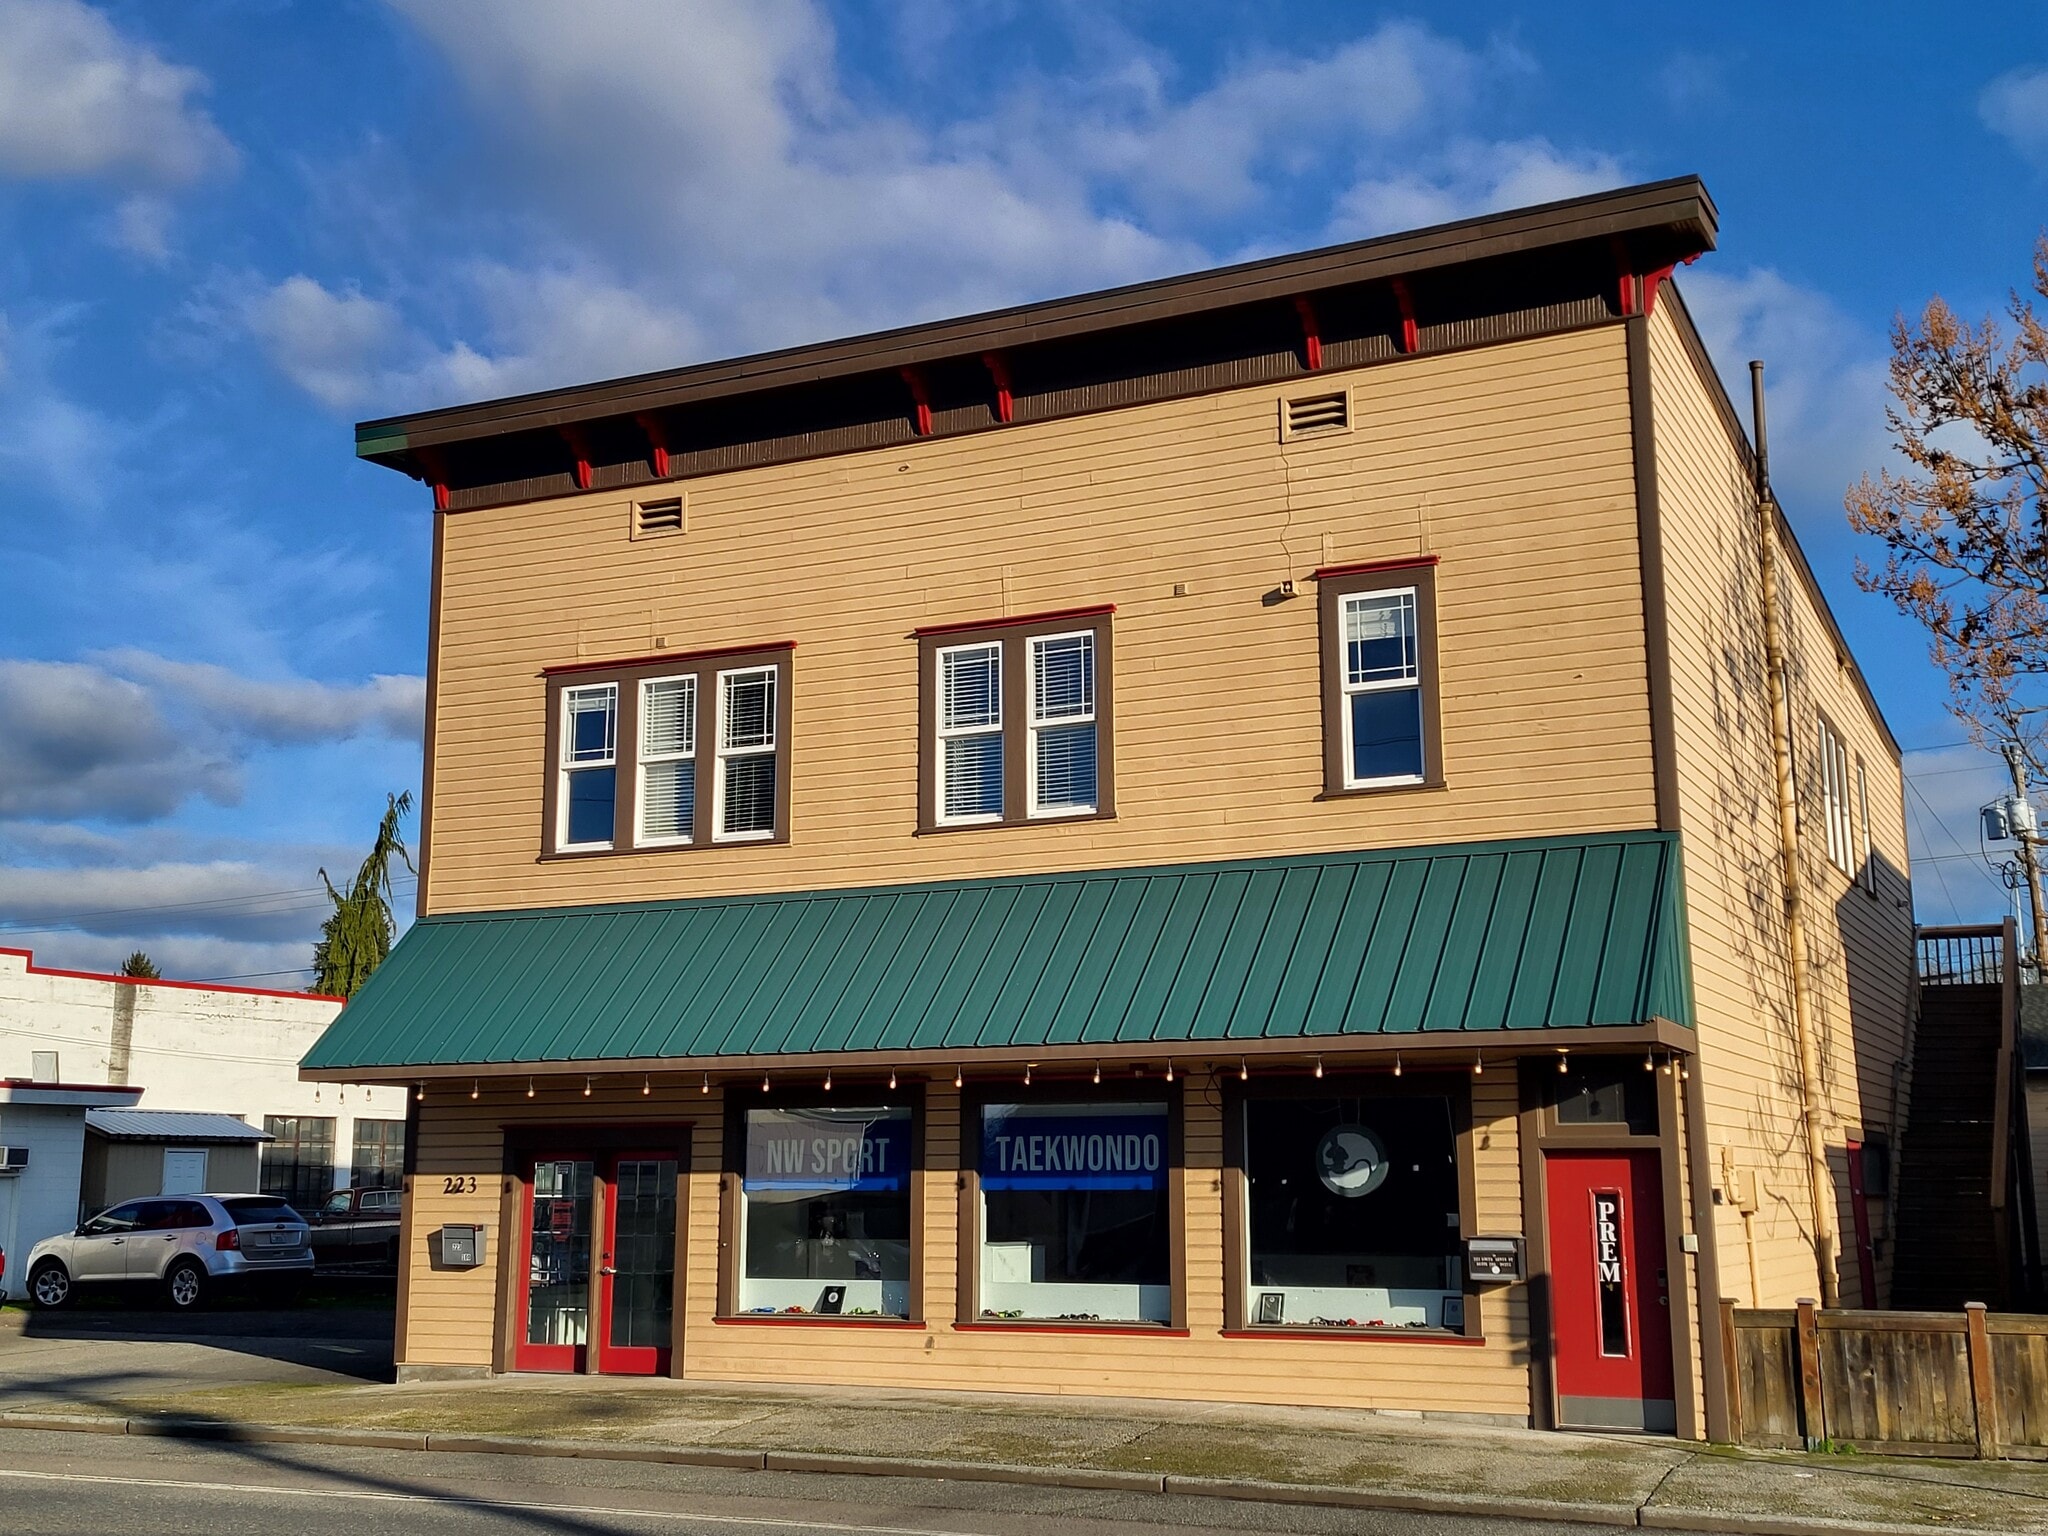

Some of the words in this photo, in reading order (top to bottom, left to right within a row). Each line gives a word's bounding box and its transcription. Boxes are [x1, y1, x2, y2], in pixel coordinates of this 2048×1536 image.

[767, 1138, 806, 1174] NW
[811, 1138, 890, 1174] SPORT
[995, 1134, 1160, 1172] TAEKWONDO
[443, 1176, 477, 1194] 223
[1597, 1201, 1622, 1283] PREM
